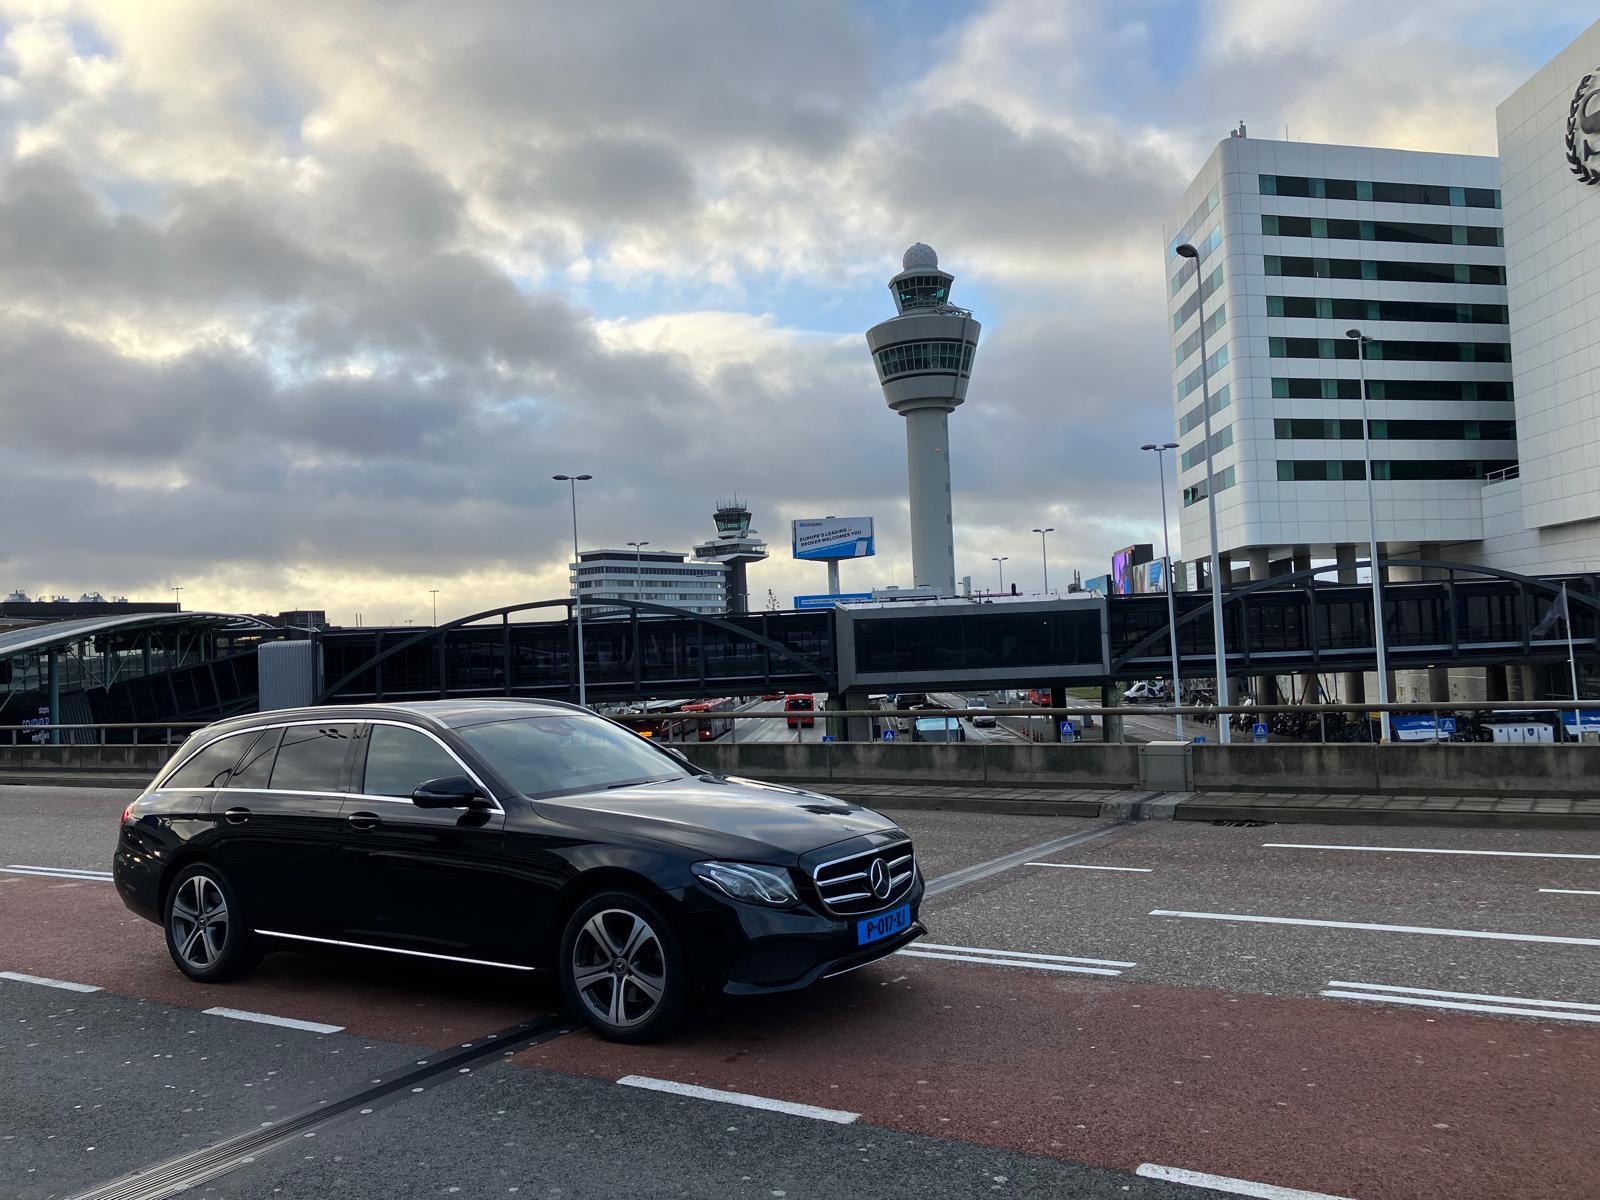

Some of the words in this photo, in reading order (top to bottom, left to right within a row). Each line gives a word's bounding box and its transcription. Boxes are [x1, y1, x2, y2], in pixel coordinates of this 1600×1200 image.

[800, 533, 824, 542] EUROPE'S
[825, 528, 847, 537] LEADING
[801, 539, 821, 547] BROKER
[822, 532, 850, 543] WELCOMES
[867, 909, 905, 939] P-017-XJ
